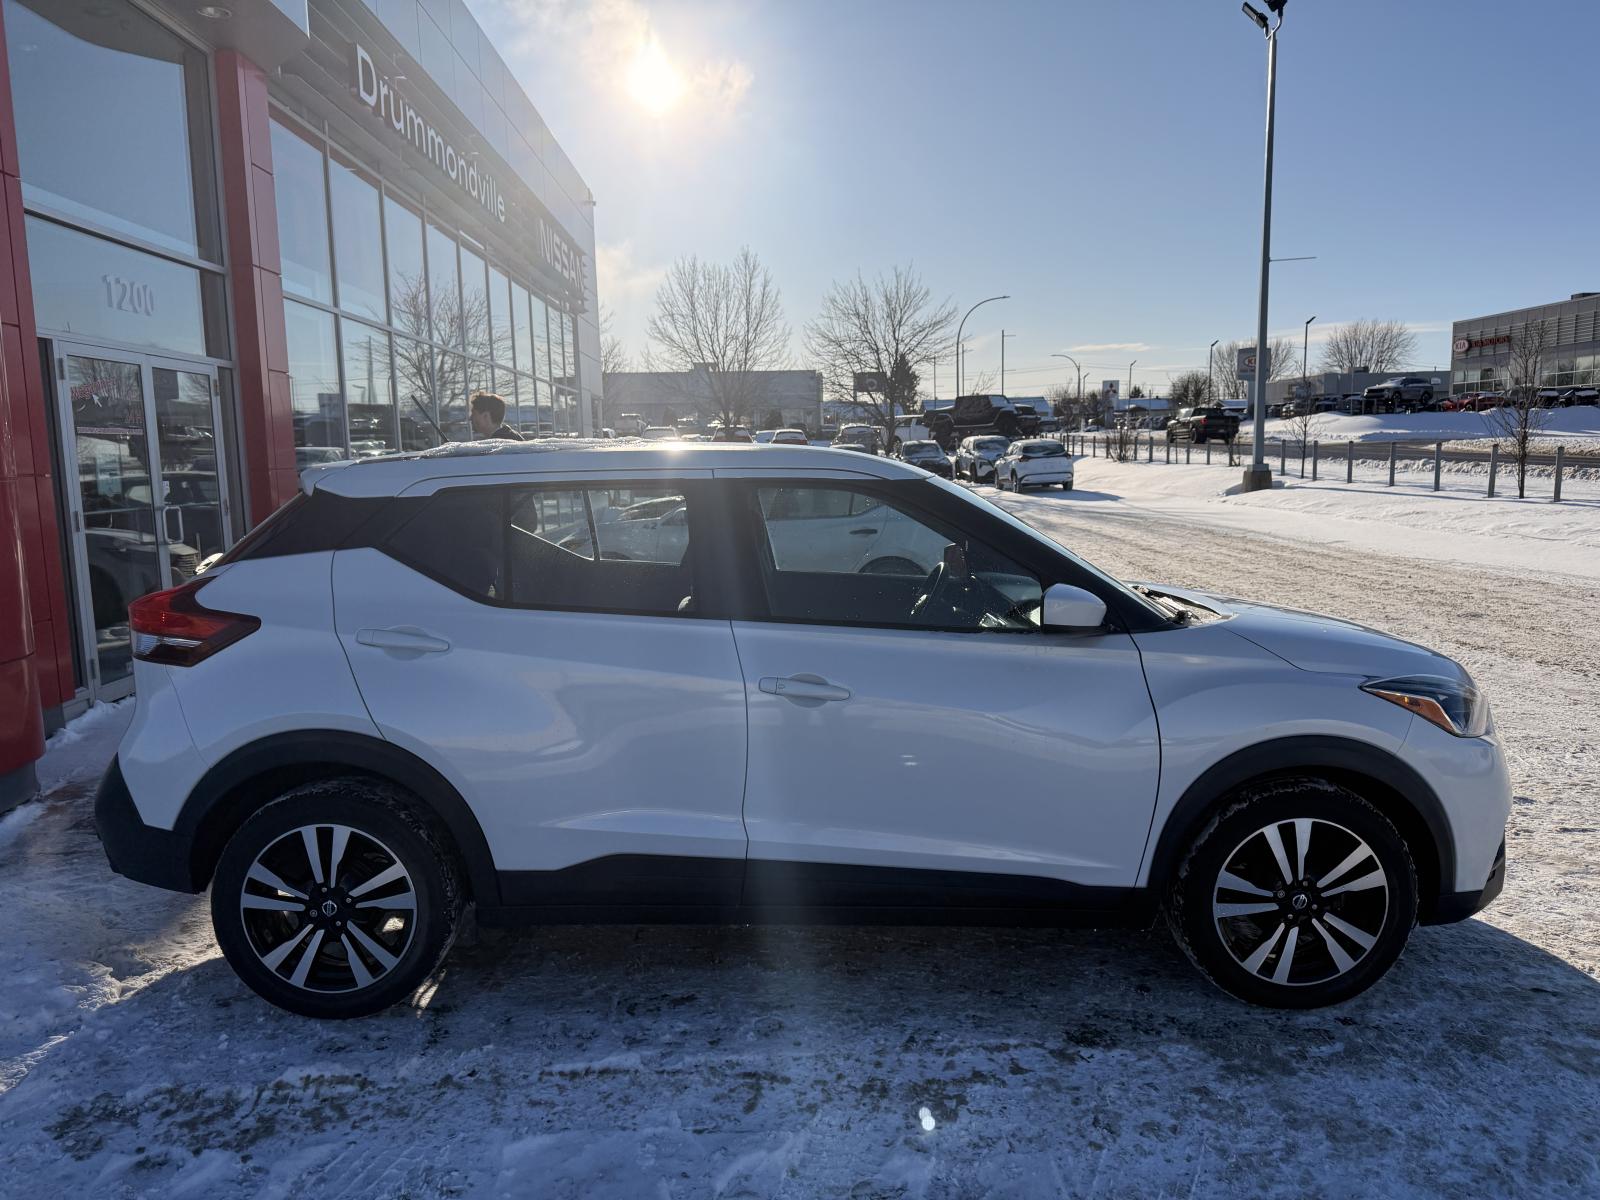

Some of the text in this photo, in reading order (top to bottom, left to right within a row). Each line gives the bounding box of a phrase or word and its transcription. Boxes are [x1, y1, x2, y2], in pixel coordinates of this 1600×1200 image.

[357, 43, 505, 222] Drummondville
[540, 219, 584, 292] NISSAN
[102, 274, 154, 317] 1200
